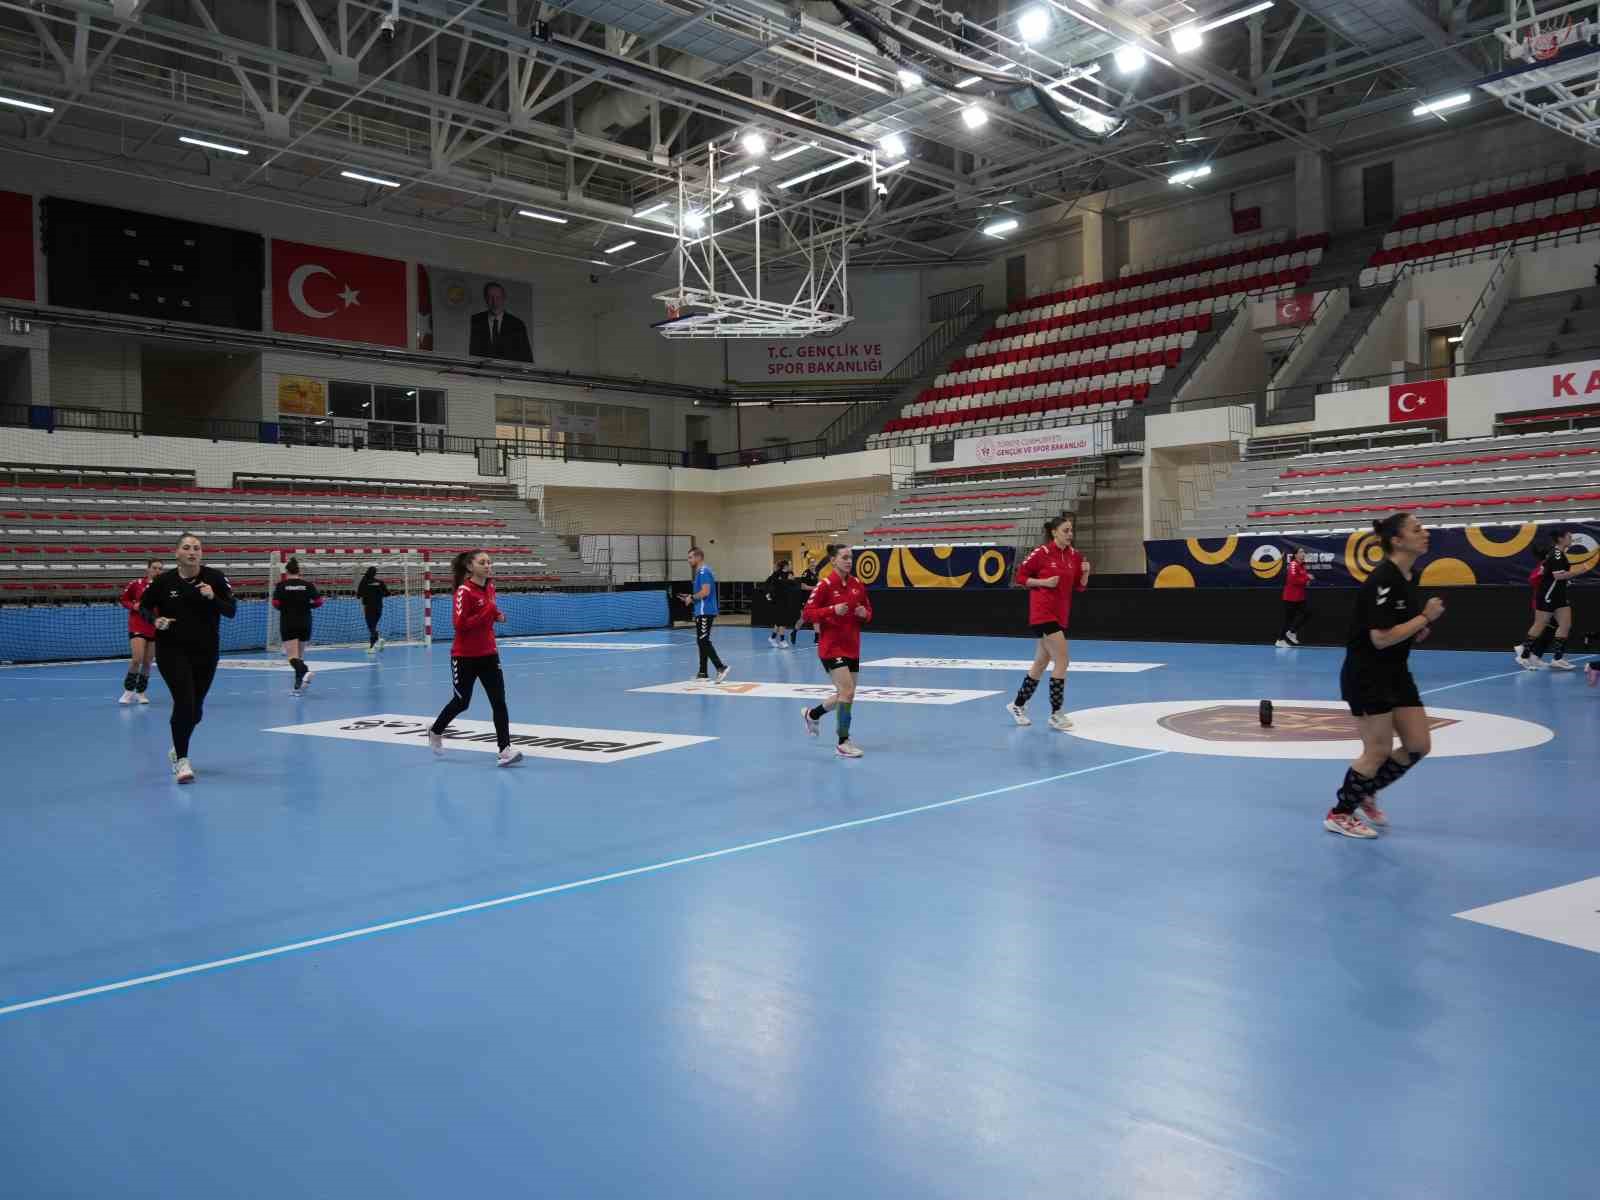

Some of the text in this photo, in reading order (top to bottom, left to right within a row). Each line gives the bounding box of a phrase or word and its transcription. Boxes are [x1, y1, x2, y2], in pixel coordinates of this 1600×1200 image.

[767, 343, 881, 360] T.C. GENÇLİK VE
[768, 359, 882, 375] SPOR BAKANLIĞI
[1552, 370, 1600, 397] KA
